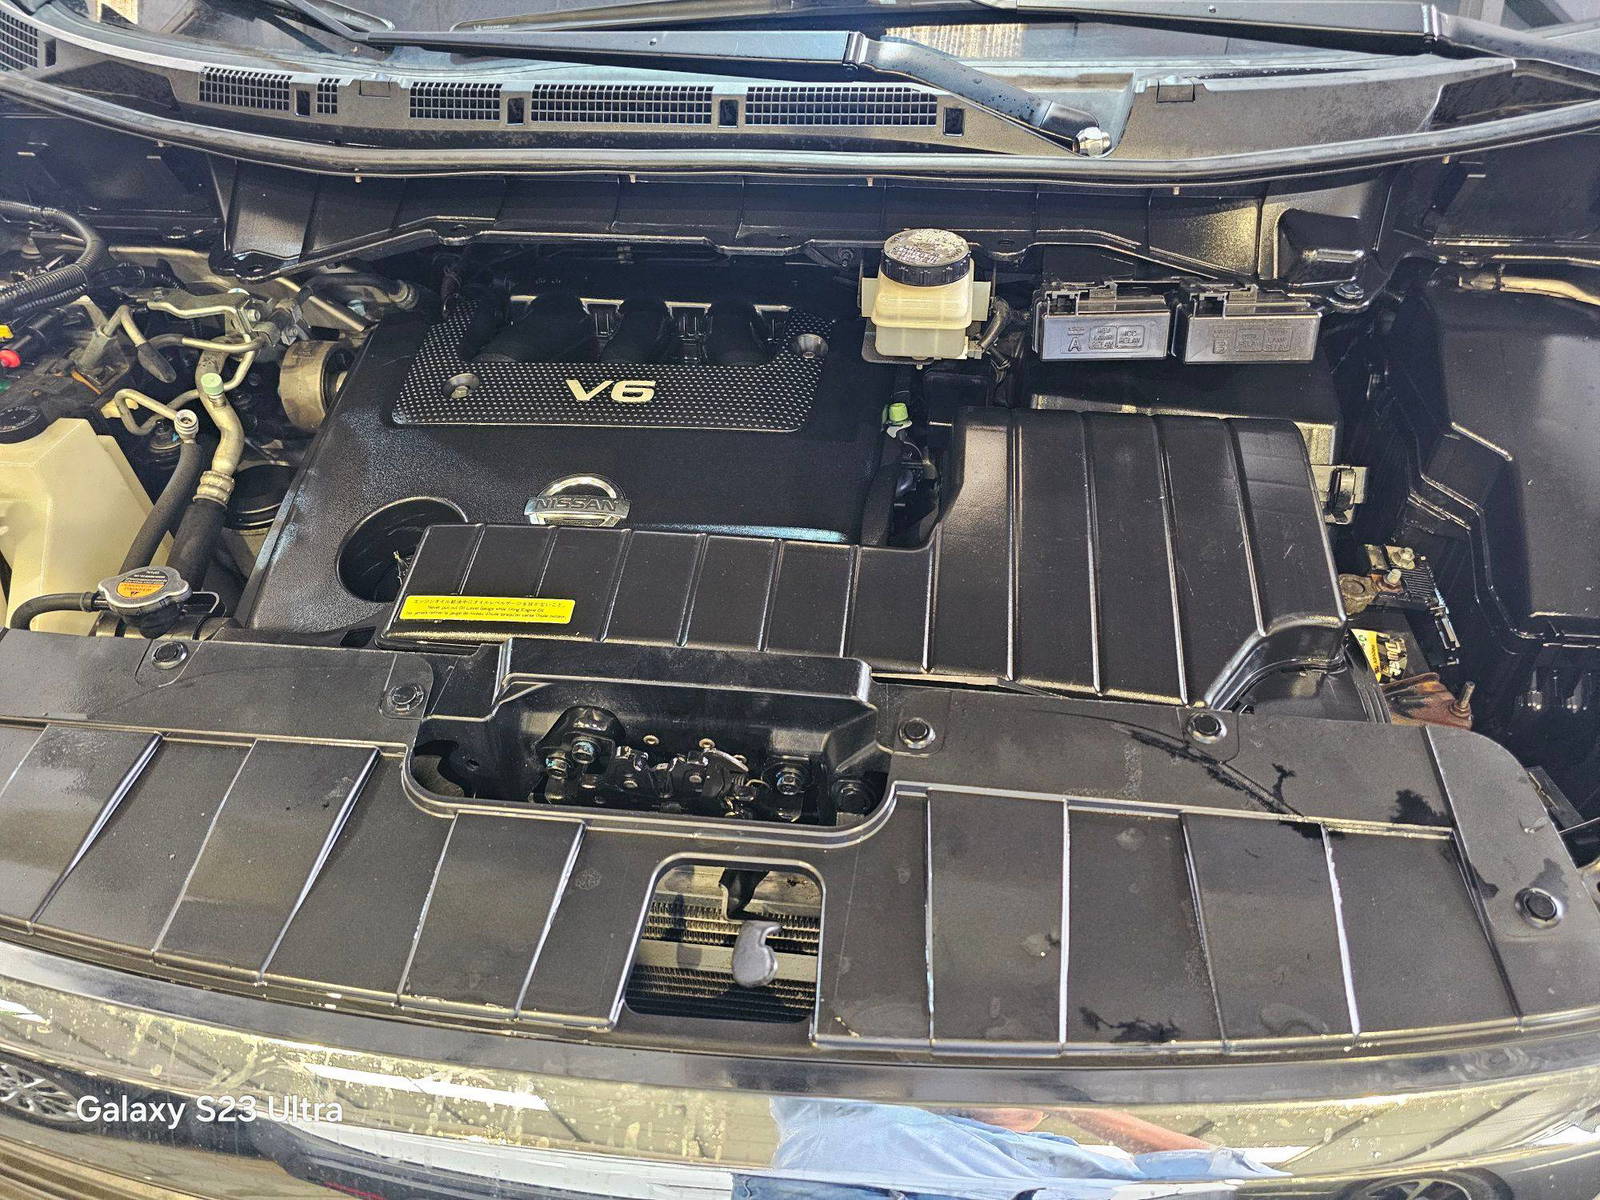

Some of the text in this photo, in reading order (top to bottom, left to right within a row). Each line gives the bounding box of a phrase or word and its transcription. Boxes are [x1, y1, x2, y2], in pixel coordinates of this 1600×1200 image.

[1068, 337, 1081, 352] A
[565, 379, 657, 403] V6
[535, 498, 617, 512] NISSAN
